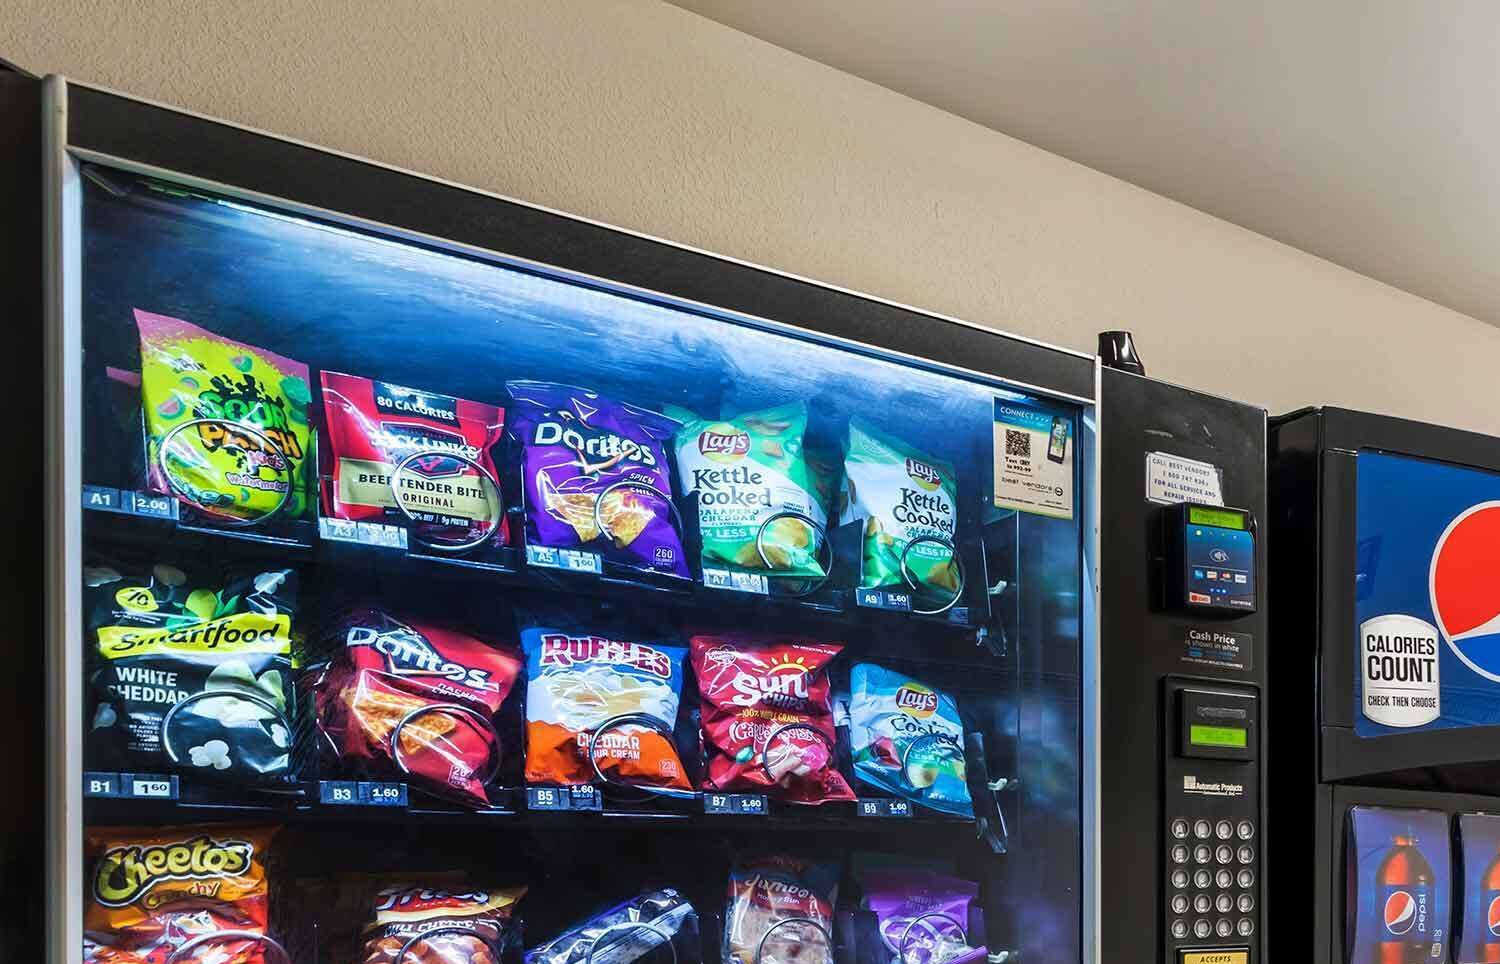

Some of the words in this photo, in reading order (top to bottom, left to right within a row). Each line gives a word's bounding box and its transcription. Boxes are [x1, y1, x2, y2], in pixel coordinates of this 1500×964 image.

[197, 391, 288, 433] SOUR
[377, 396, 393, 408] 80
[396, 399, 455, 421] CALORIES
[1000, 406, 1035, 420] CONNECT
[535, 421, 656, 466] Doritos
[702, 431, 748, 455] Lay's
[399, 479, 453, 494] TENDER
[630, 472, 655, 485] SPICY
[692, 466, 763, 490] Kettle
[90, 491, 111, 507] A1
[136, 497, 168, 512] 2.00
[403, 492, 455, 508] ORIGINAL
[698, 486, 772, 507] ooked
[900, 487, 950, 515] Kettle
[893, 505, 953, 536] Cooked
[716, 528, 745, 537] LESS
[538, 553, 553, 563] A5
[656, 548, 673, 558] 260
[711, 575, 726, 585] A7
[865, 594, 877, 604] A9
[110, 619, 280, 652] Smartfood
[1189, 630, 1211, 641] Cash
[1213, 633, 1236, 645] Price
[1366, 634, 1435, 655] CALORIES
[346, 627, 494, 692] Doritos
[540, 634, 673, 680] RUFFLES
[116, 667, 178, 686] WHITE
[108, 685, 189, 706] HEDDAR
[720, 671, 809, 706] Sun
[899, 688, 936, 710] Lay's
[1368, 695, 1390, 706] CHECK
[1392, 696, 1409, 707] THEN
[1411, 696, 1436, 708] CHOOSE
[577, 732, 640, 750] CHEDDAR
[611, 750, 640, 760] CREAM
[90, 781, 112, 793] B1
[333, 788, 351, 800] B3
[372, 788, 399, 798] 1.60
[537, 790, 553, 802] B5
[571, 785, 594, 794] 1.60
[1197, 781, 1221, 792] Automatic
[1221, 784, 1243, 792] Products
[712, 796, 726, 806] B7
[741, 799, 762, 808] 1.60
[864, 803, 877, 814] B9
[889, 803, 907, 811] 1.60
[96, 837, 254, 905] Cheetos
[744, 874, 809, 899] Jumbo
[783, 896, 801, 905] Bun
[1417, 894, 1427, 932] pepsi
